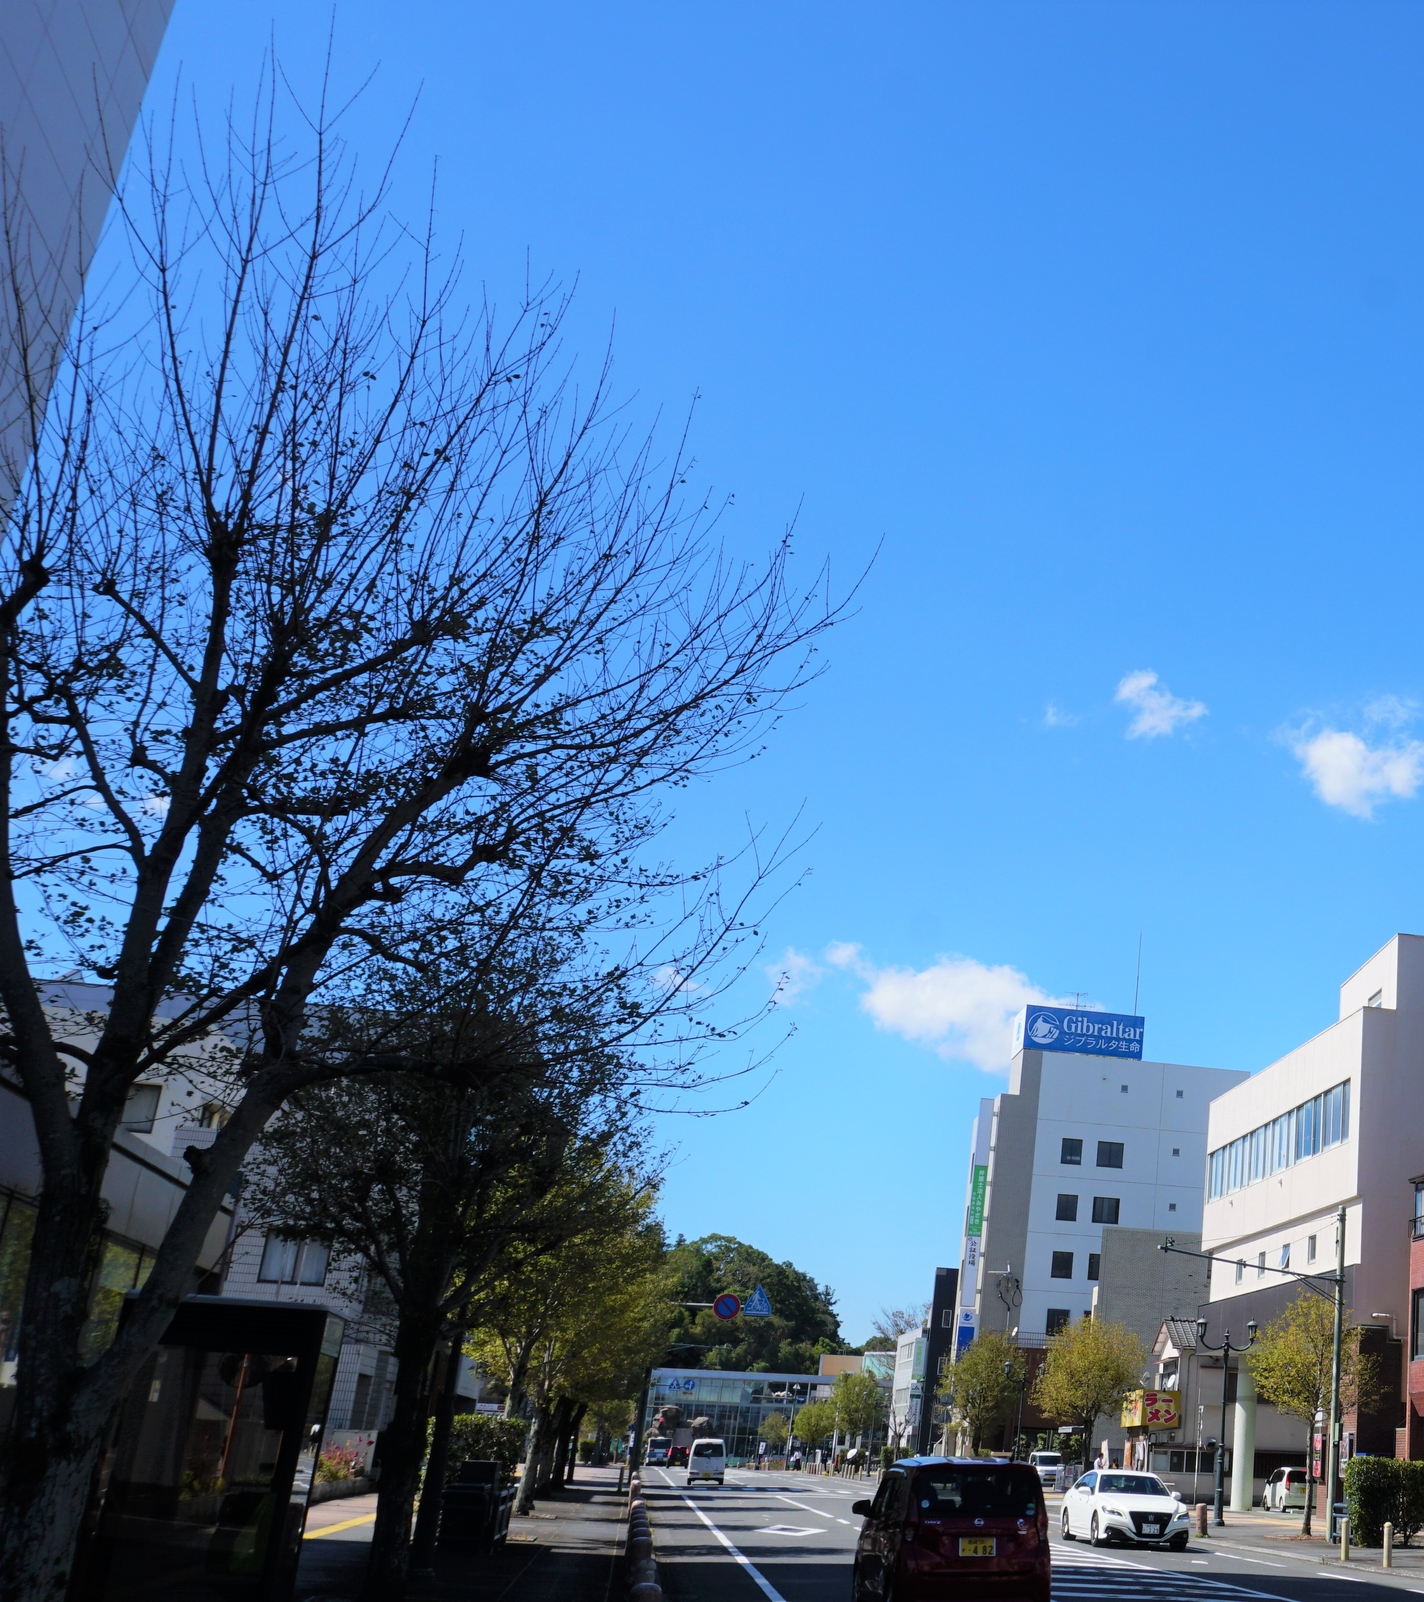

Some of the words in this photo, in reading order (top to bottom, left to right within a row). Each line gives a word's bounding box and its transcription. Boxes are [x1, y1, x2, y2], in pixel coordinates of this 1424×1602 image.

[1062, 1014, 1144, 1041] Gibraltar
[1063, 1034, 1141, 1053] ジブラルタ生命
[1144, 1392, 1174, 1407] ラー
[1146, 1408, 1178, 1424] メン
